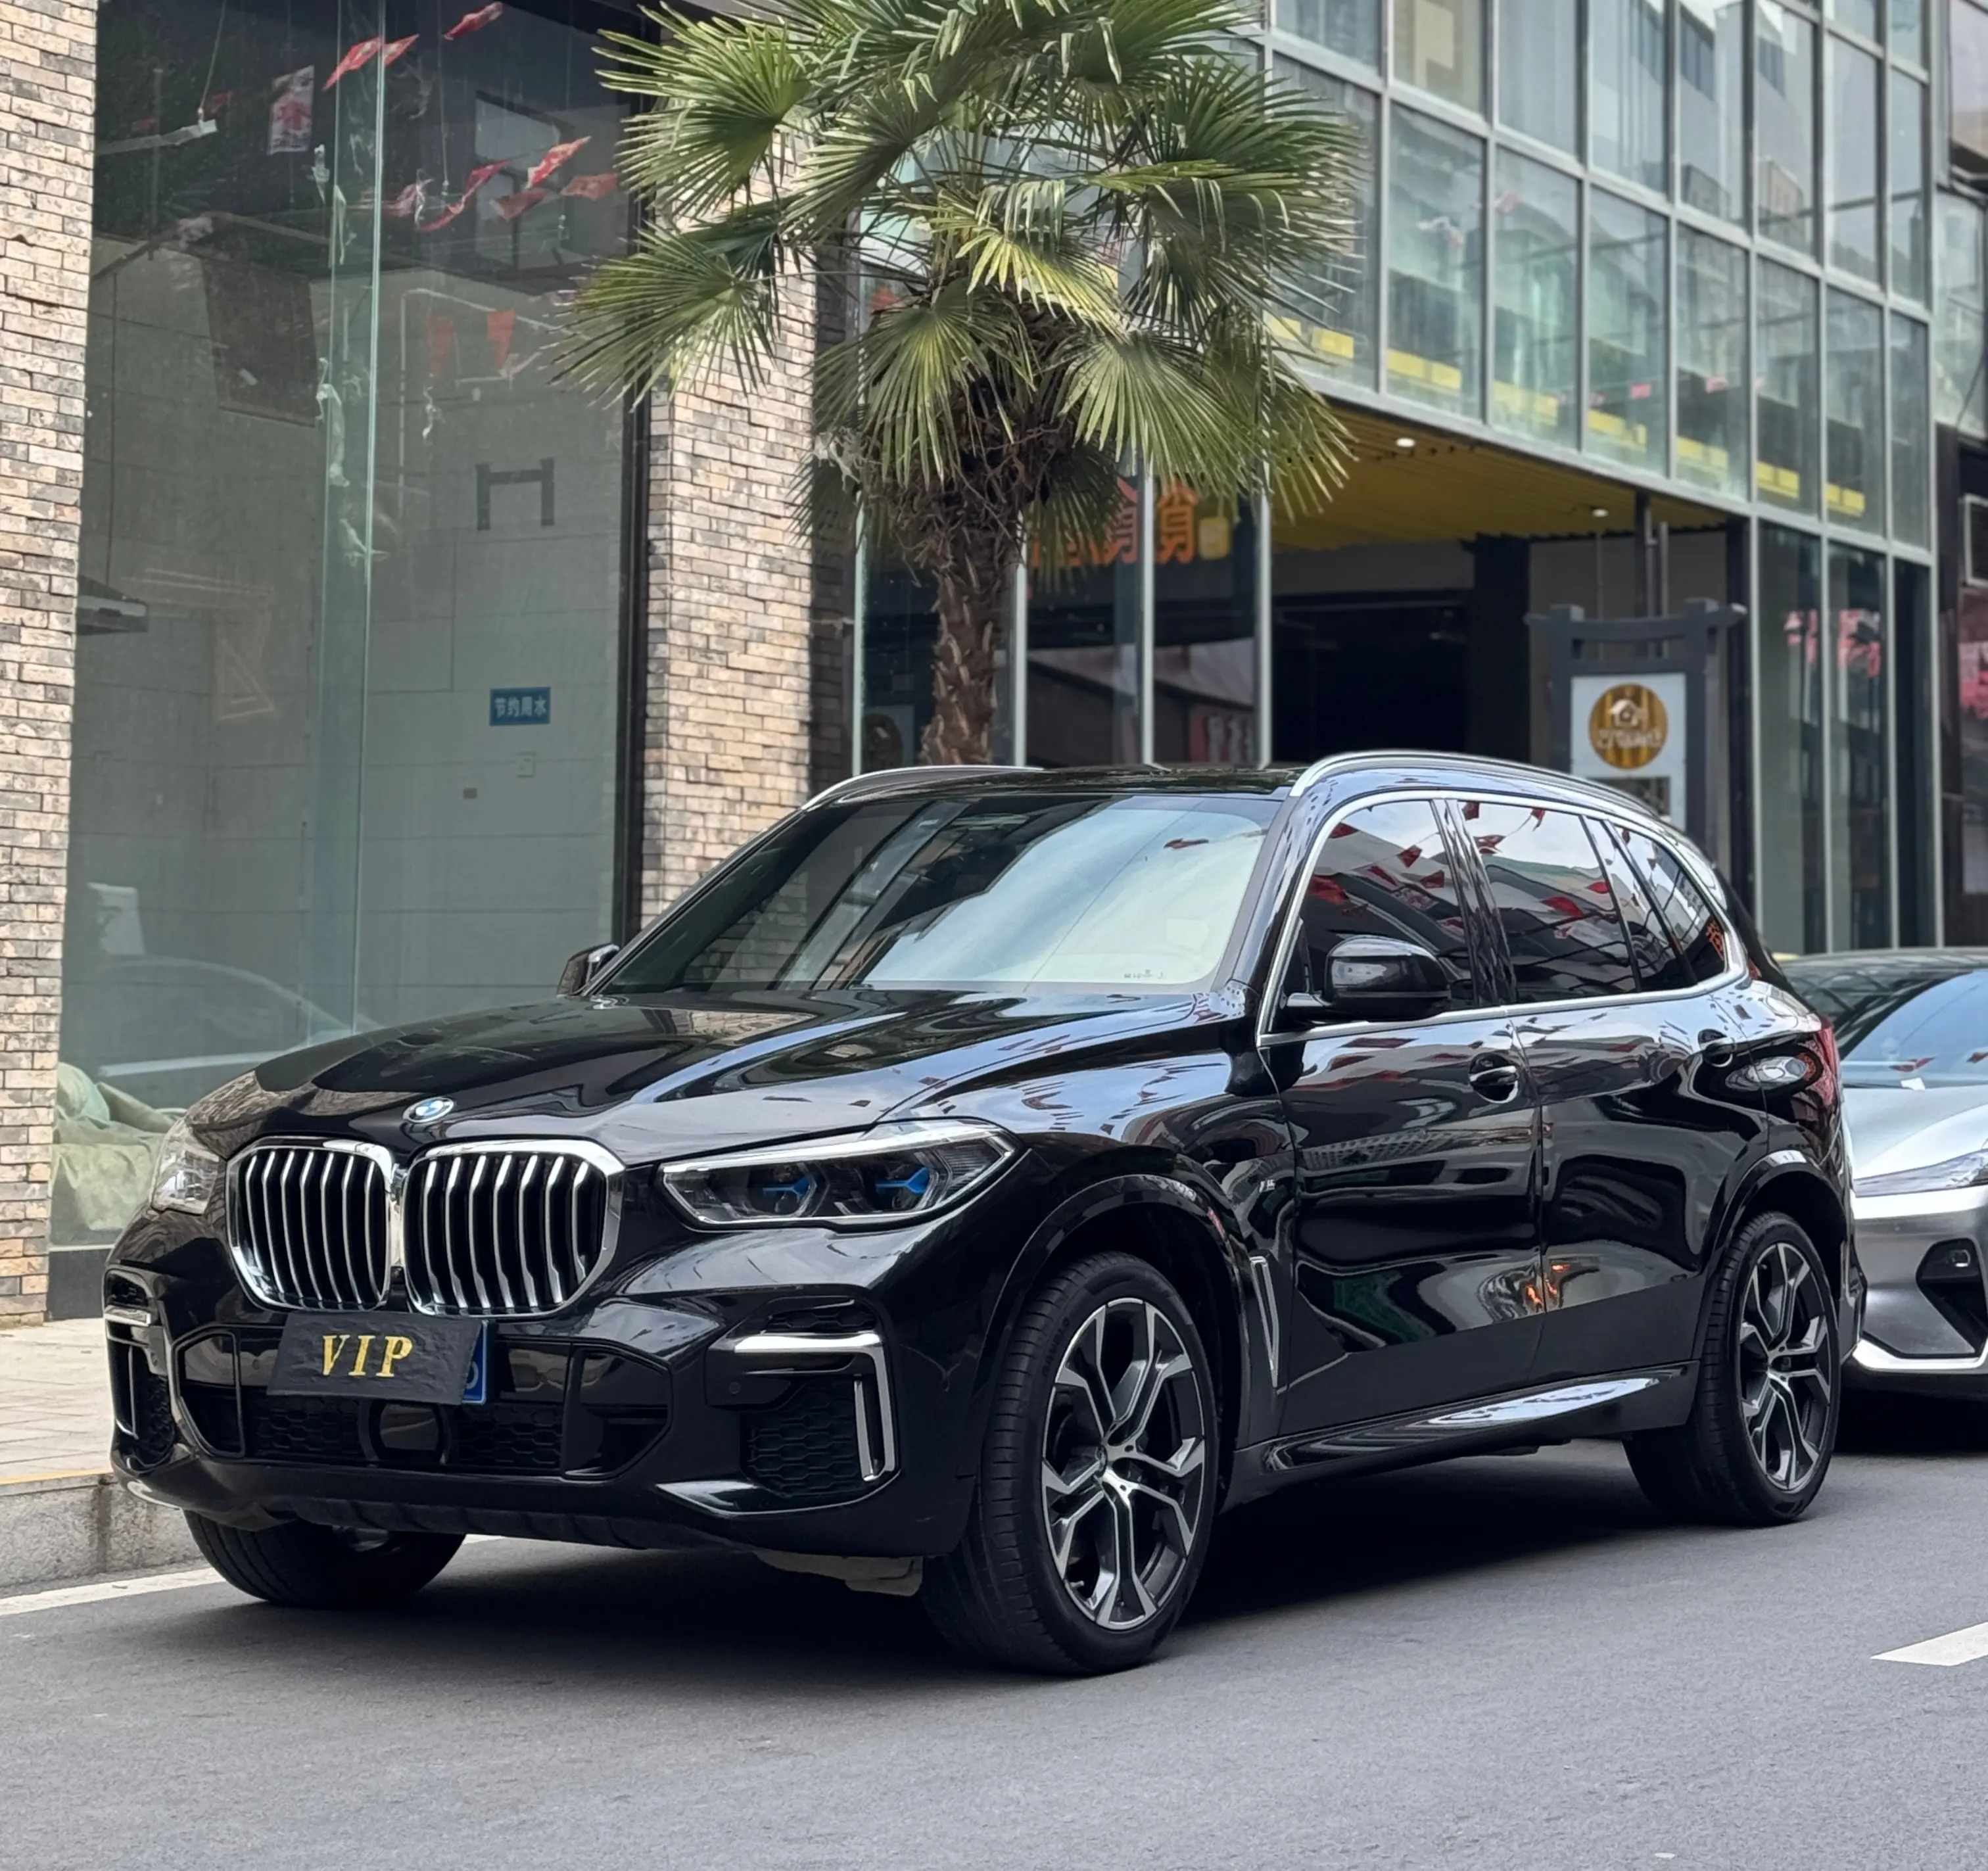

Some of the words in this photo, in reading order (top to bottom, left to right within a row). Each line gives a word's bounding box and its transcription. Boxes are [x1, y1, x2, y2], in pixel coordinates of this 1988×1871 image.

[494, 696, 546, 718] 节约用水
[321, 1334, 414, 1378] VIP
